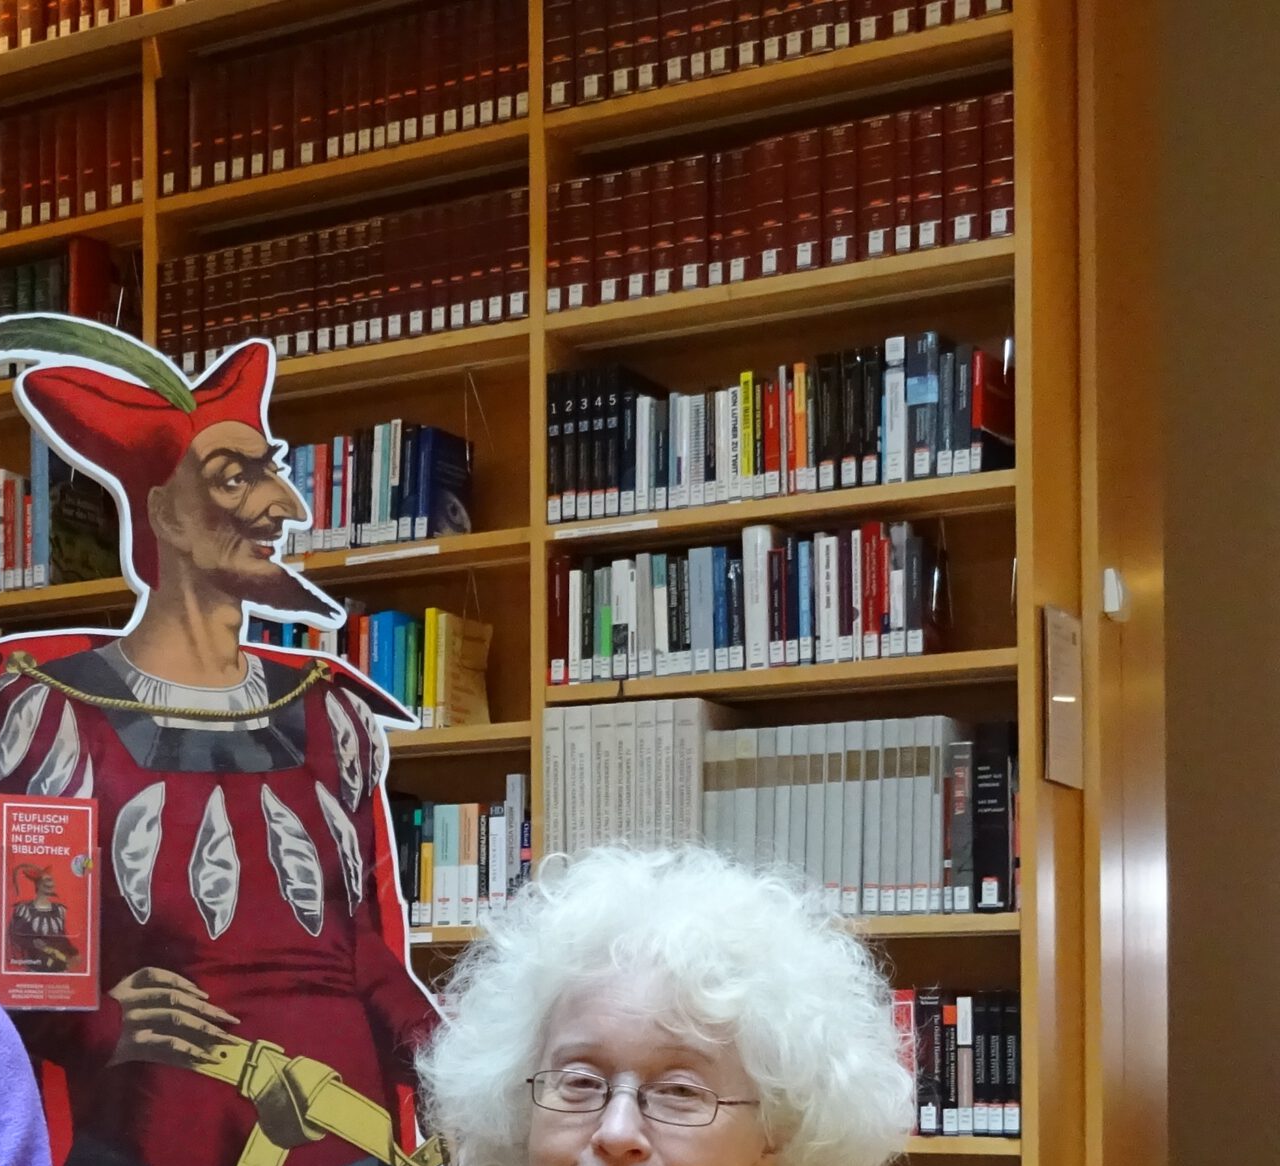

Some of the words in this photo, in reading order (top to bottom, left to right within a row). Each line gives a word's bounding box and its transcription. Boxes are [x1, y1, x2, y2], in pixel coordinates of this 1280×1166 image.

[565, 400, 573, 412] 2
[580, 398, 588, 410] 3
[595, 396, 602, 407] 4
[609, 394, 616, 406] 5
[551, 403, 556, 414] 1
[731, 441, 738, 453] ZU
[11, 824, 64, 834] MEPHISTO
[11, 834, 22, 842] IN
[25, 835, 45, 844] DER
[11, 844, 70, 856] BIBLIOTHEK
